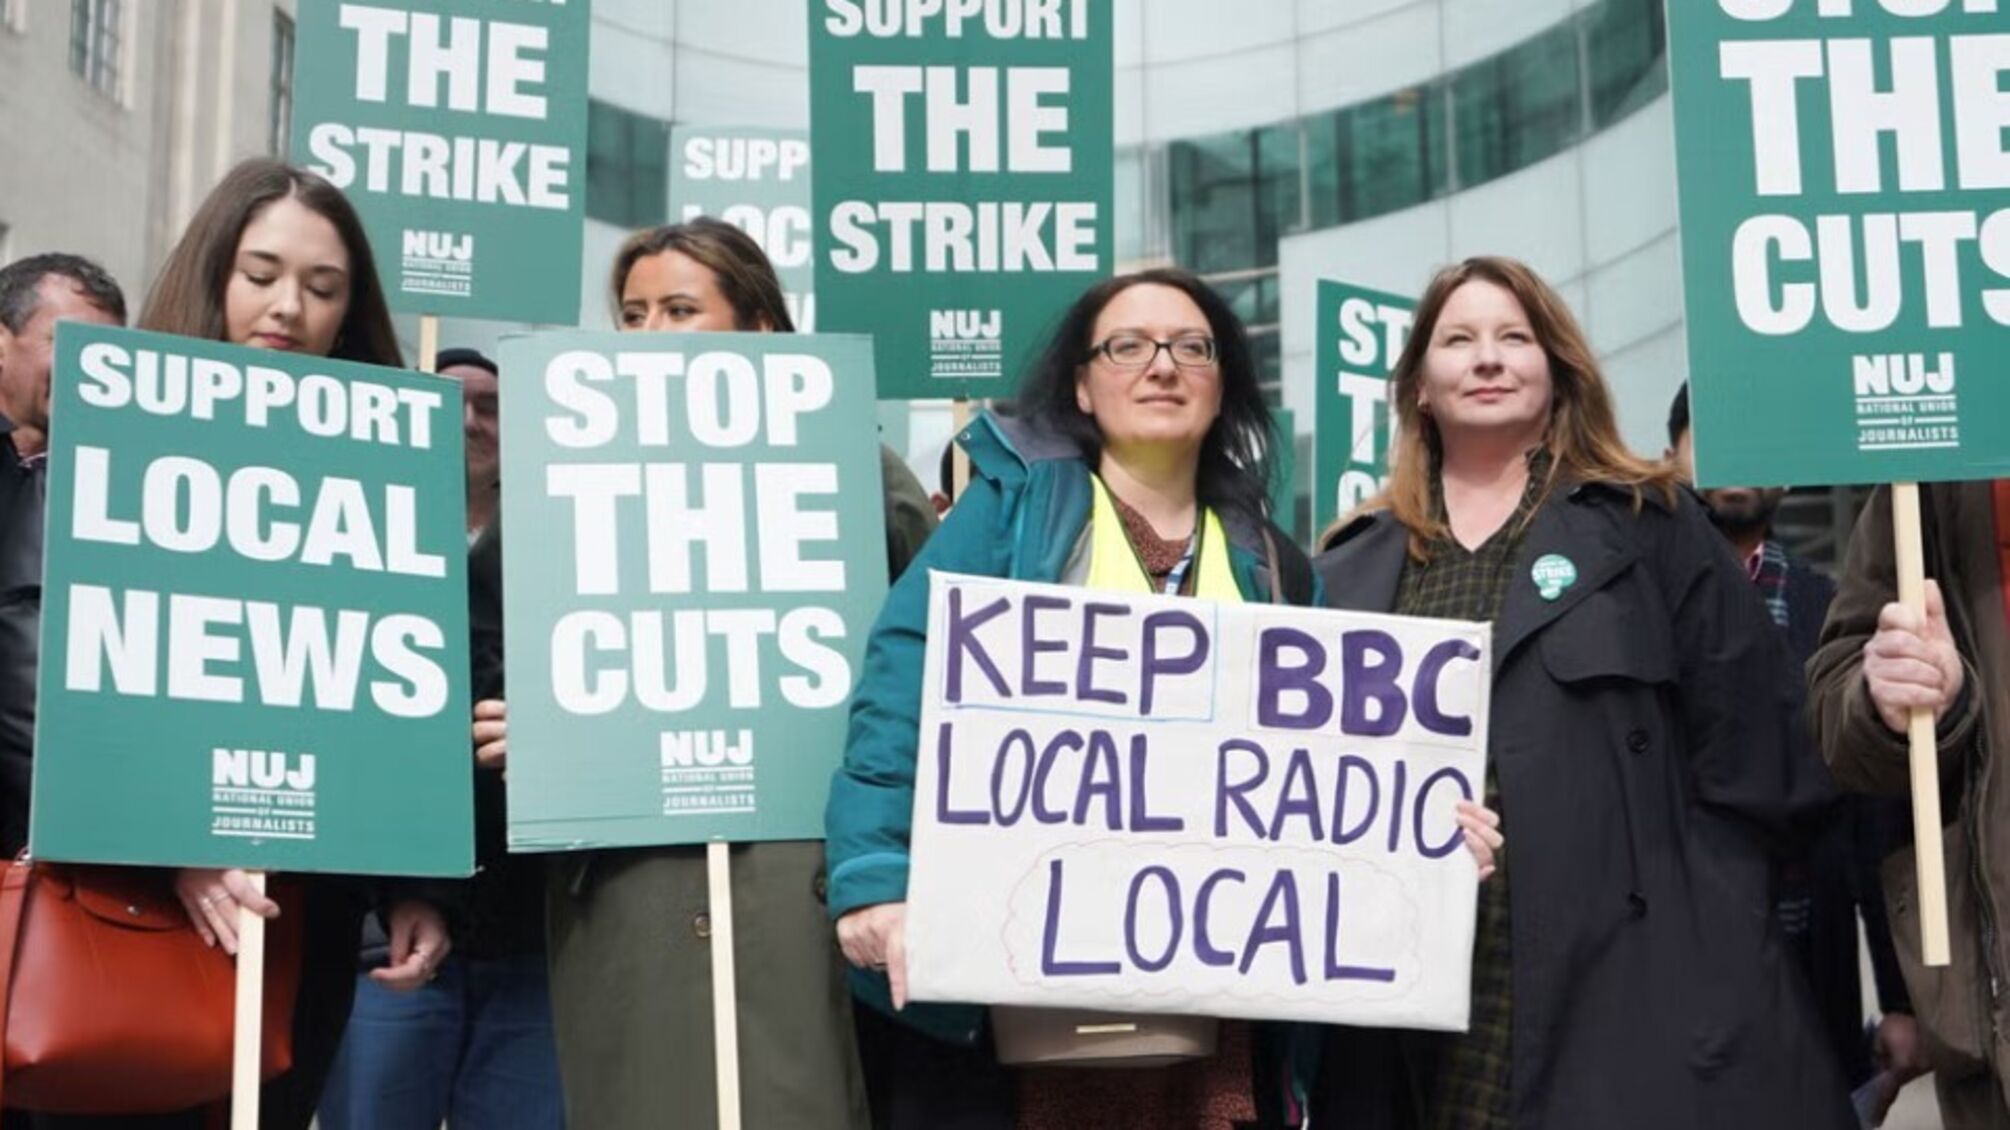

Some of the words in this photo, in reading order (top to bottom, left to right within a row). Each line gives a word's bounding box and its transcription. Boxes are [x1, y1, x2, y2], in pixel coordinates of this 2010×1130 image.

[825, 0, 1087, 39] SUPPORT
[340, 4, 548, 119] THE
[854, 66, 1072, 173] THE
[1719, 33, 2010, 196] THE
[306, 122, 570, 210] STRIKE
[684, 137, 809, 181] SUPP
[402, 229, 473, 259] NUJ
[829, 200, 1098, 273] STRIKE
[930, 309, 1002, 338] NUJ
[1338, 297, 1412, 371] ST
[78, 342, 442, 449] SUPPORT
[544, 350, 833, 448] STOP
[1852, 352, 1955, 395] NUJ
[1857, 401, 1915, 414] NATIONAL
[1859, 427, 1959, 442] JOURNALISTS
[72, 445, 446, 578] LOCAL
[546, 462, 846, 595] THE
[65, 583, 449, 718] NEWS
[551, 606, 851, 715] CUTS
[945, 587, 1210, 716] KEEP
[1257, 627, 1481, 738] BBC
[212, 748, 316, 789] NUJ
[660, 729, 753, 766] NUJ
[211, 816, 315, 833] JOURNALISTS
[213, 792, 273, 805] NATIONAL
[663, 792, 755, 808] JOURNALISTS
[936, 722, 1185, 833] LOCAL
[1214, 738, 1475, 860] RADIO
[1041, 858, 1396, 986] LOCAL
